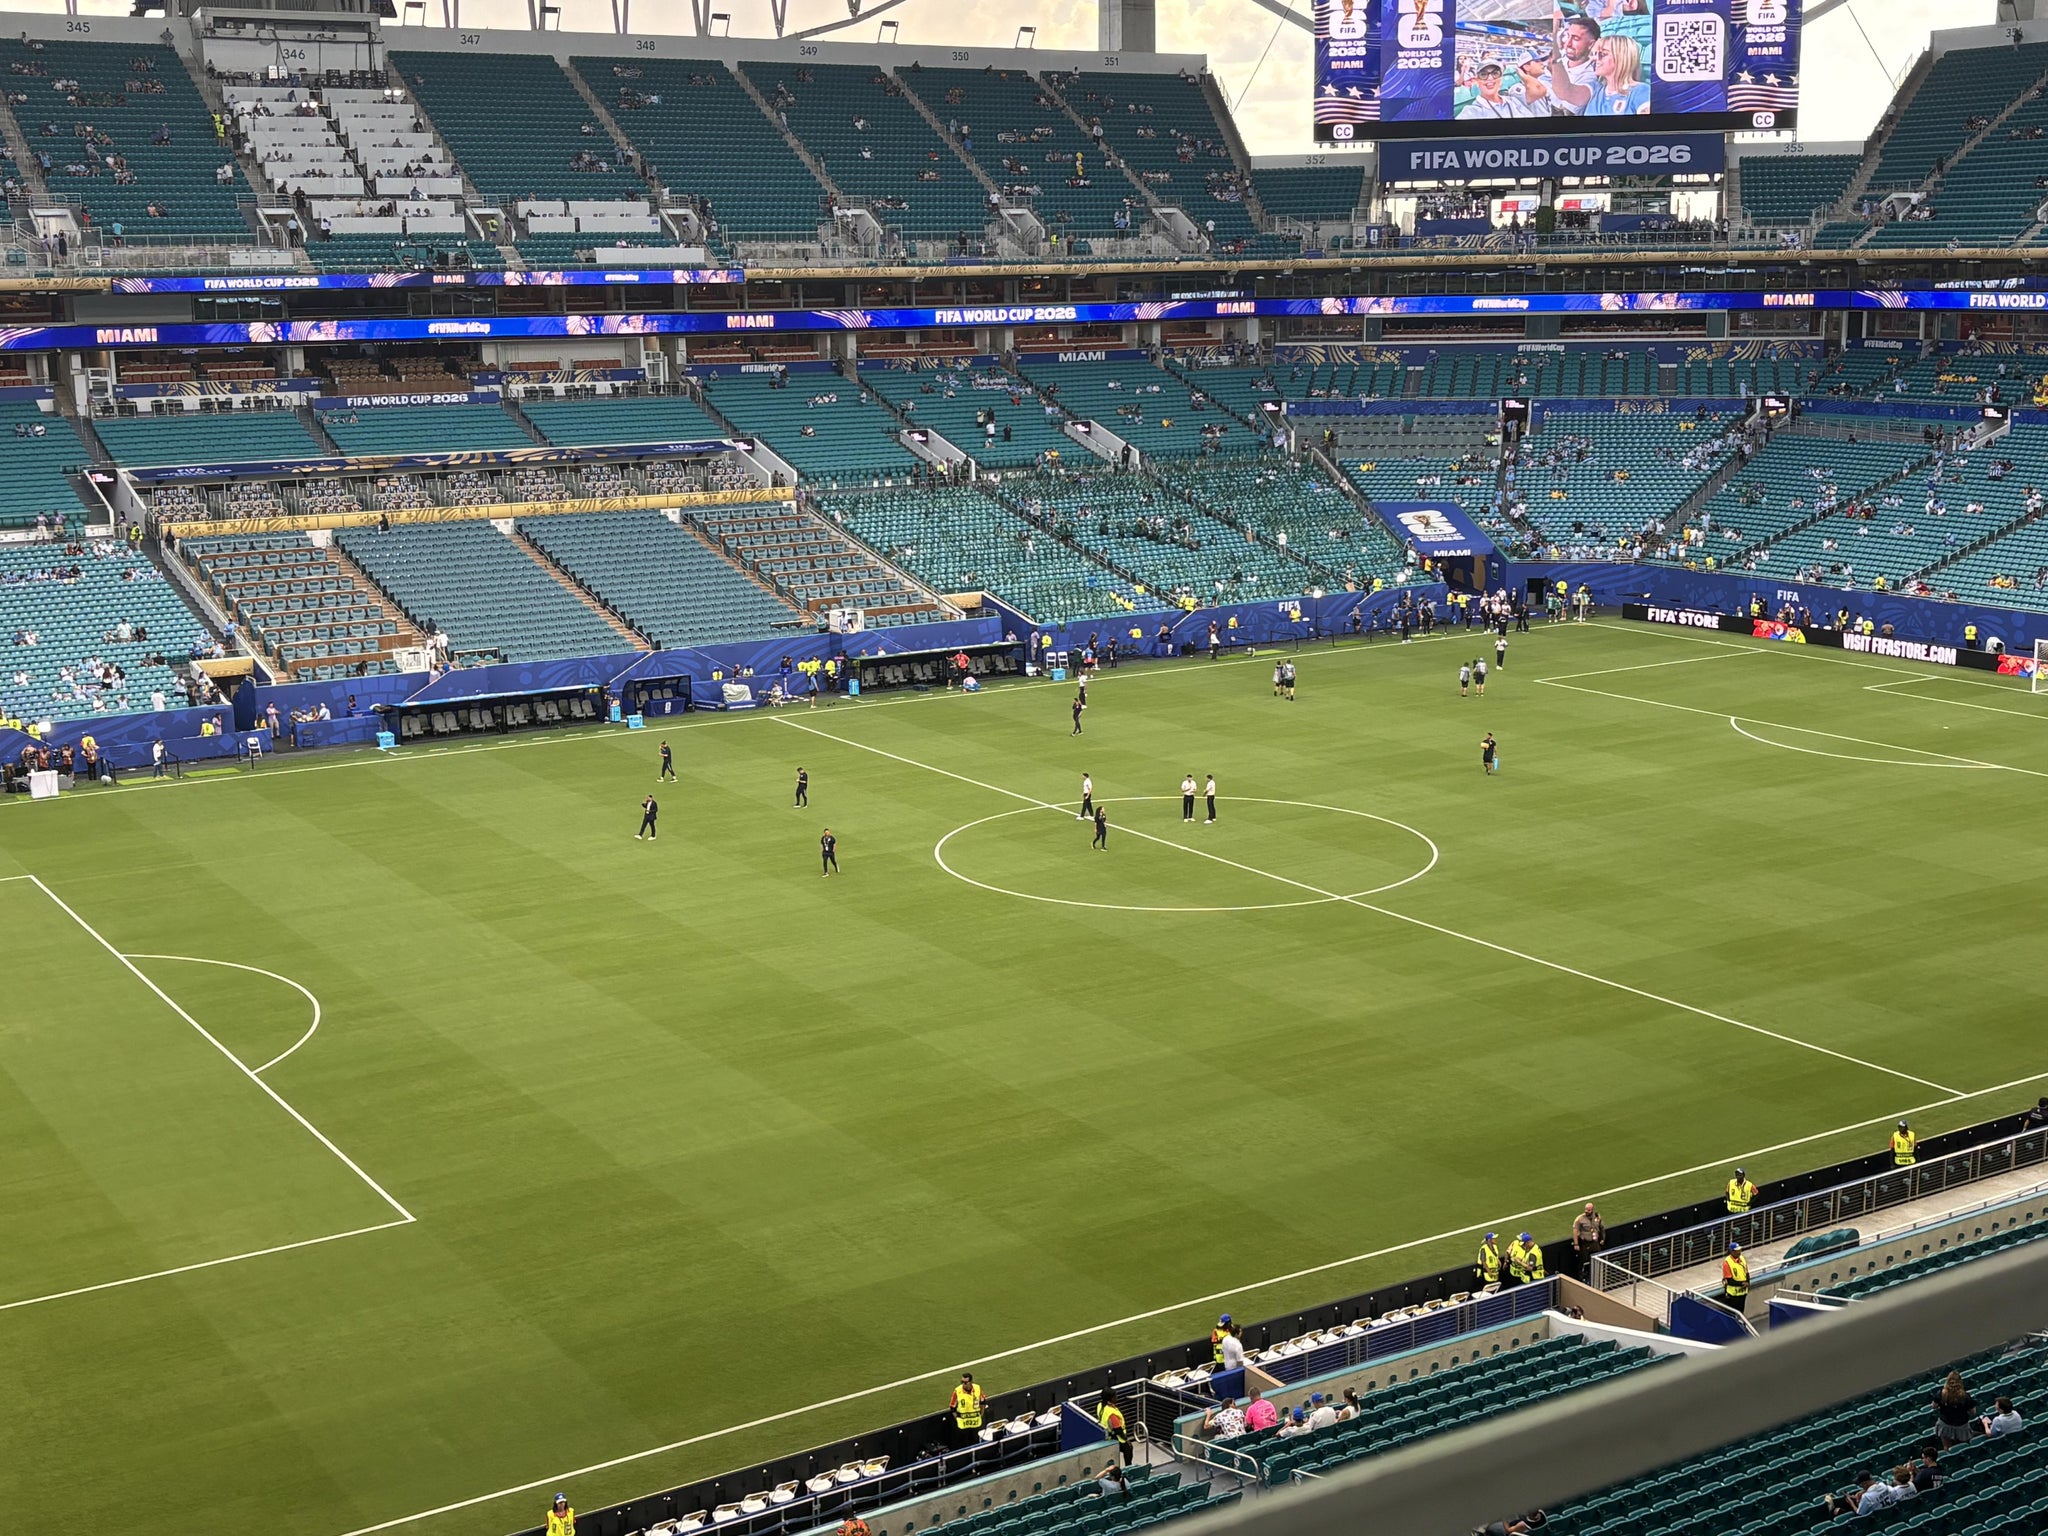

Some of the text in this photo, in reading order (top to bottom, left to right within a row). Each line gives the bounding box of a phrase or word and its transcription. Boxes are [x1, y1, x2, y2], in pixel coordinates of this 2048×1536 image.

[66, 21, 90, 33] 345
[460, 34, 480, 45] 347
[1410, 34, 1430, 42] FIFA
[1745, 32, 1786, 43] 2026
[636, 40, 656, 51] 348
[800, 46, 818, 56] 349
[283, 48, 306, 60] 346
[952, 51, 969, 61] 350
[1328, 47, 1366, 57] 2026
[1748, 47, 1782, 56] MIAMI
[1104, 56, 1119, 66] 351
[1331, 60, 1364, 70] MIAMI
[1397, 58, 1442, 70] 2026
[1756, 114, 1772, 126] CC
[1336, 126, 1351, 137] CC
[1784, 142, 1804, 152] 355
[1305, 154, 1326, 164] 352
[1410, 144, 1692, 170] FIFA WORLD CUP 2026
[204, 278, 319, 289] FIFA WORLD CUP 2026
[432, 274, 465, 284] MIAMI
[1763, 293, 1815, 306] MIAMI
[1970, 294, 2045, 308] FIFA WORLD
[1216, 302, 1255, 314] MIAMI
[935, 306, 1077, 324] FIFA WORLD CUP 2026
[727, 315, 774, 329] MIAMI
[96, 328, 158, 344] MIAMI
[1058, 351, 1106, 362] MIAMI
[347, 393, 469, 408] FIFA WORLD CUP 2026
[1777, 590, 1800, 602] FIFA
[1278, 601, 1300, 612] FIFA
[1648, 608, 1720, 629] FIFA STORE
[1843, 632, 1958, 666] VISIT FIFASTORE.COM
